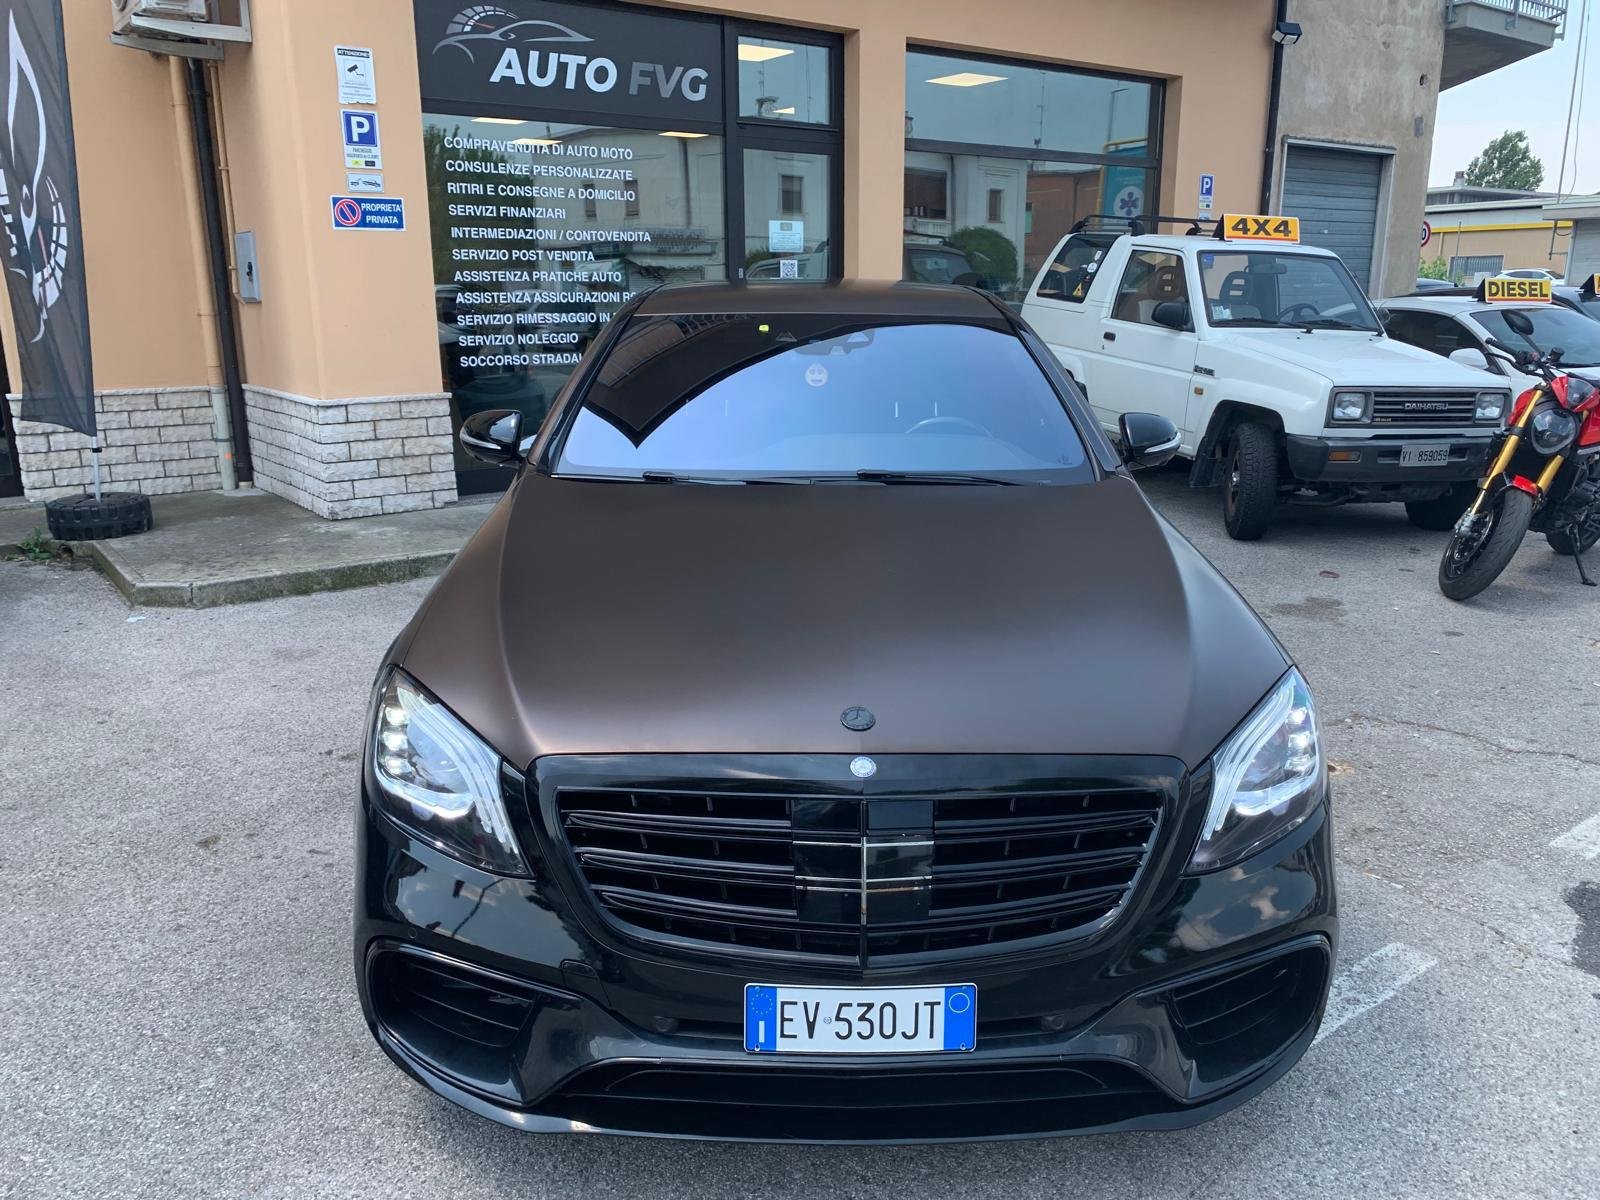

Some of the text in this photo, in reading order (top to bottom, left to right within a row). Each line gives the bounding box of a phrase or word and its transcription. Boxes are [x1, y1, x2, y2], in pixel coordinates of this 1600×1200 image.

[489, 47, 709, 101] AUTO FVG
[350, 115, 370, 142] P
[443, 136, 633, 160] COMPRAVENDITA DI AUTO MOTO
[445, 160, 633, 180] CONSULENZE PERSONALIZZATE
[447, 182, 636, 201] RITIRI E CONSEGNE A DOMICILIO
[1203, 177, 1211, 194] P
[448, 204, 566, 219] SERVIZI FINANZIARI
[366, 215, 399, 224] PRIVATA
[1231, 217, 1292, 237] 4X4
[451, 227, 556, 240] INTERMEDIAZIONI
[566, 230, 652, 242] CONTOVENDITA
[452, 249, 595, 261] SERVIZIO POST VENDITA
[454, 270, 622, 282] ASSISTENZA PRATICHE AUTO
[1488, 280, 1549, 298] DIESEL
[456, 291, 531, 304] ASSISTENZA
[534, 291, 620, 303] ASSICURAZIONI
[457, 312, 610, 326] SERVIZIO RIMESSAGGIO IN
[458, 333, 579, 347] SERVIZIO NOLEGGIO
[460, 354, 529, 367] SOCCORSO
[1404, 402, 1449, 410] DAIHATSU
[1417, 449, 1448, 462] 859059
